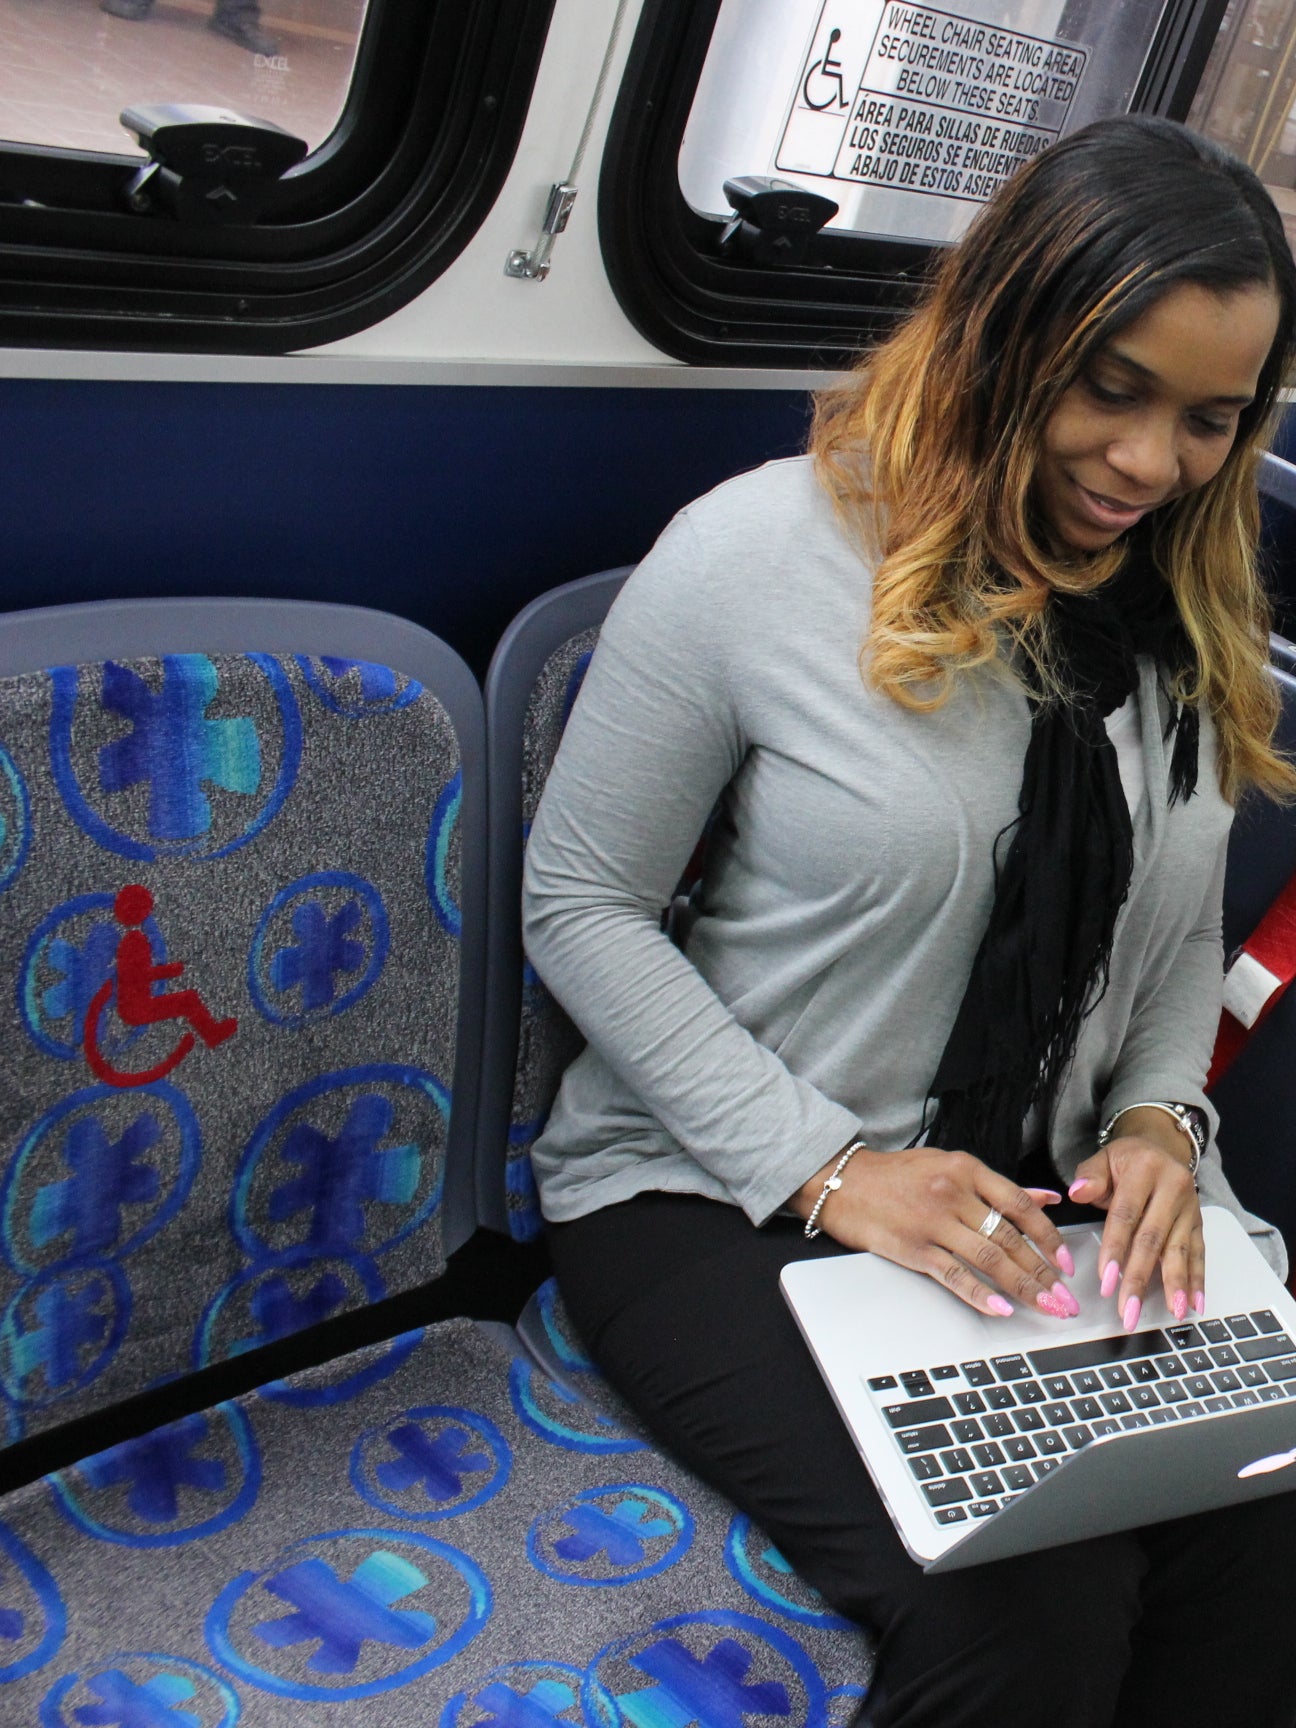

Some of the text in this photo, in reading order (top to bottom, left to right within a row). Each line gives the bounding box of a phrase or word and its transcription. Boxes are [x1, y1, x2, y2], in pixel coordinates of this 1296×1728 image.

[888, 6, 1078, 78] WHEEL CHAIR SEATING AREA.
[878, 34, 1074, 101] SECUREMENTS ARE LOCATED
[896, 69, 1040, 121] BELOW THESE SEATS.
[854, 93, 894, 127] ÁREA
[896, 107, 934, 135] PARA
[936, 116, 981, 144] SILLAS
[981, 126, 1000, 148] DE
[849, 126, 1028, 176] LOS SEGUROS SE ENCUENT
[850, 153, 899, 181] ABAJO
[899, 161, 920, 185] DE
[920, 165, 963, 192] ESTOS
[1171, 1325, 1194, 1334] command
[1221, 1351, 1228, 1359] Z
[995, 1355, 1021, 1365] command
[1194, 1356, 1202, 1364] X
[1167, 1361, 1175, 1369] C
[1083, 1377, 1092, 1385] N
[1196, 1381, 1204, 1389] D
[1054, 1382, 1063, 1390] M
[1170, 1387, 1176, 1395] F
[1140, 1392, 1148, 1400] G
[1112, 1398, 1121, 1406] H
[1085, 1403, 1089, 1411] J
[1054, 1409, 1063, 1417] K
[1025, 1414, 1032, 1422] L
[1046, 1438, 1054, 1446] O
[1017, 1443, 1024, 1452] P
